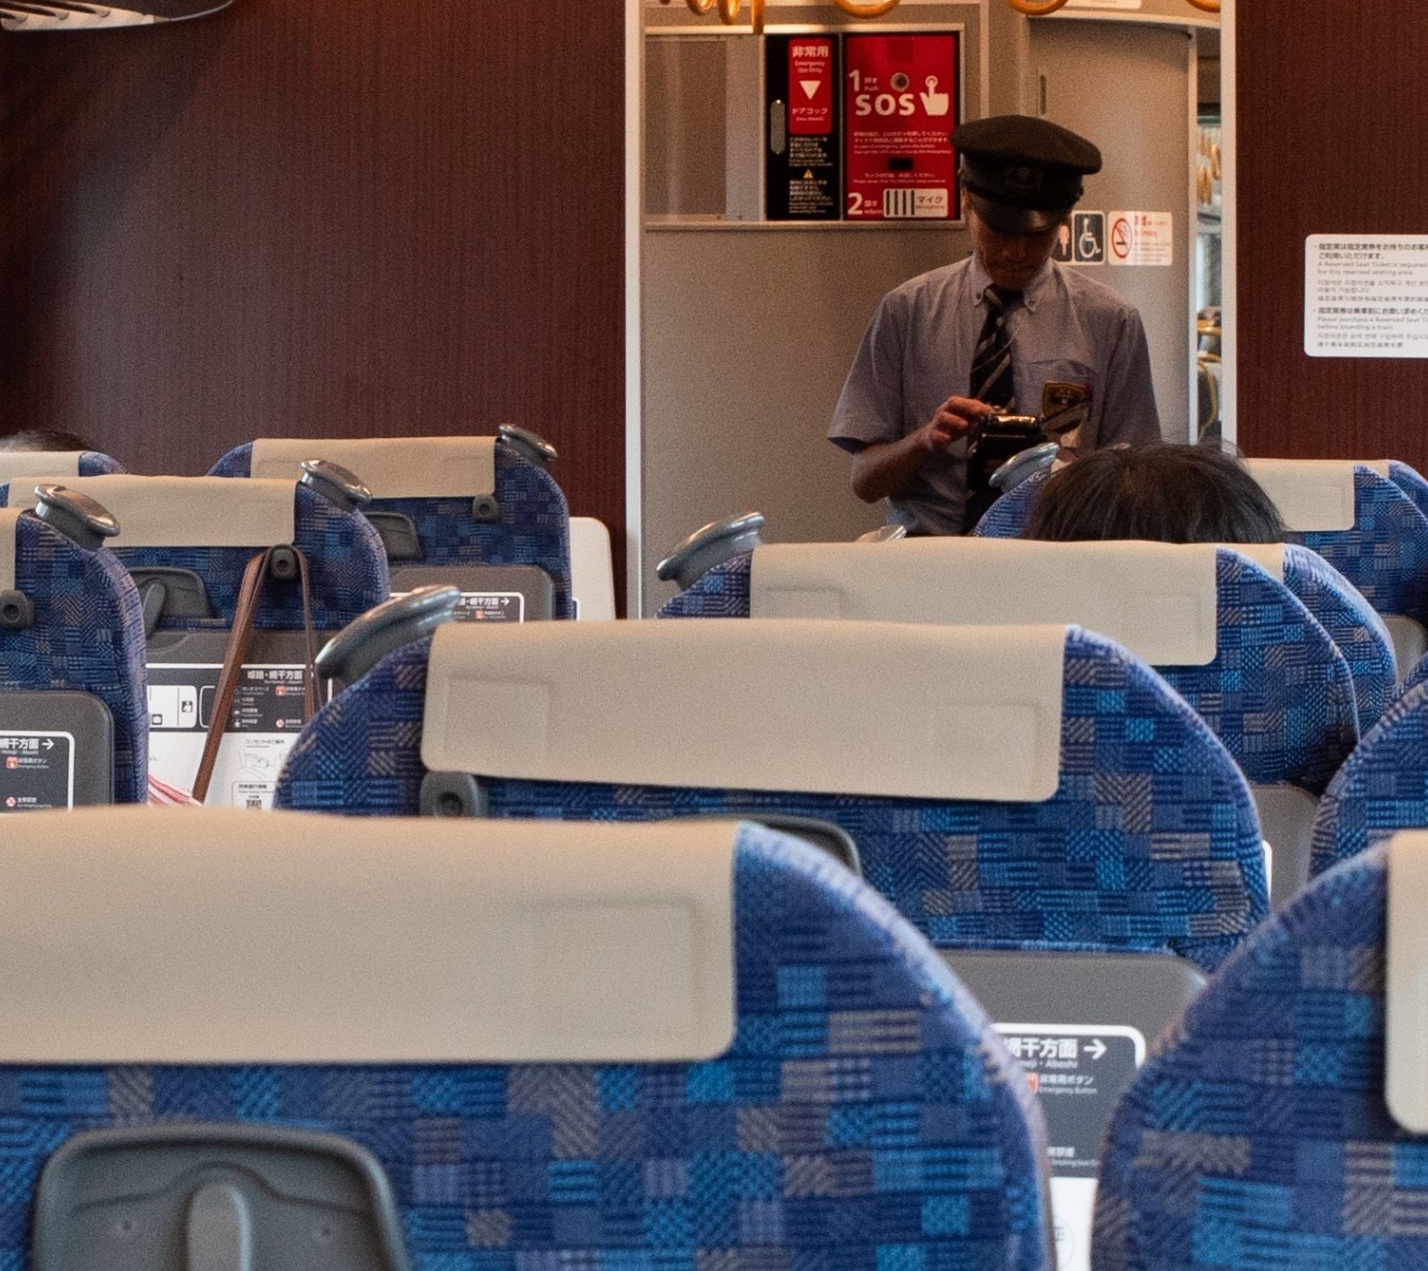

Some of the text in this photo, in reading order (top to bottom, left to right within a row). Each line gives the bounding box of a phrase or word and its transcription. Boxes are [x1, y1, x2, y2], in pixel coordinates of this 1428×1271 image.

[792, 45, 829, 58] 非常用
[848, 69, 860, 92] 1
[792, 107, 828, 115] ドアコック
[855, 93, 916, 117] SOS
[847, 192, 863, 215] 2
[917, 195, 943, 205] マイク
